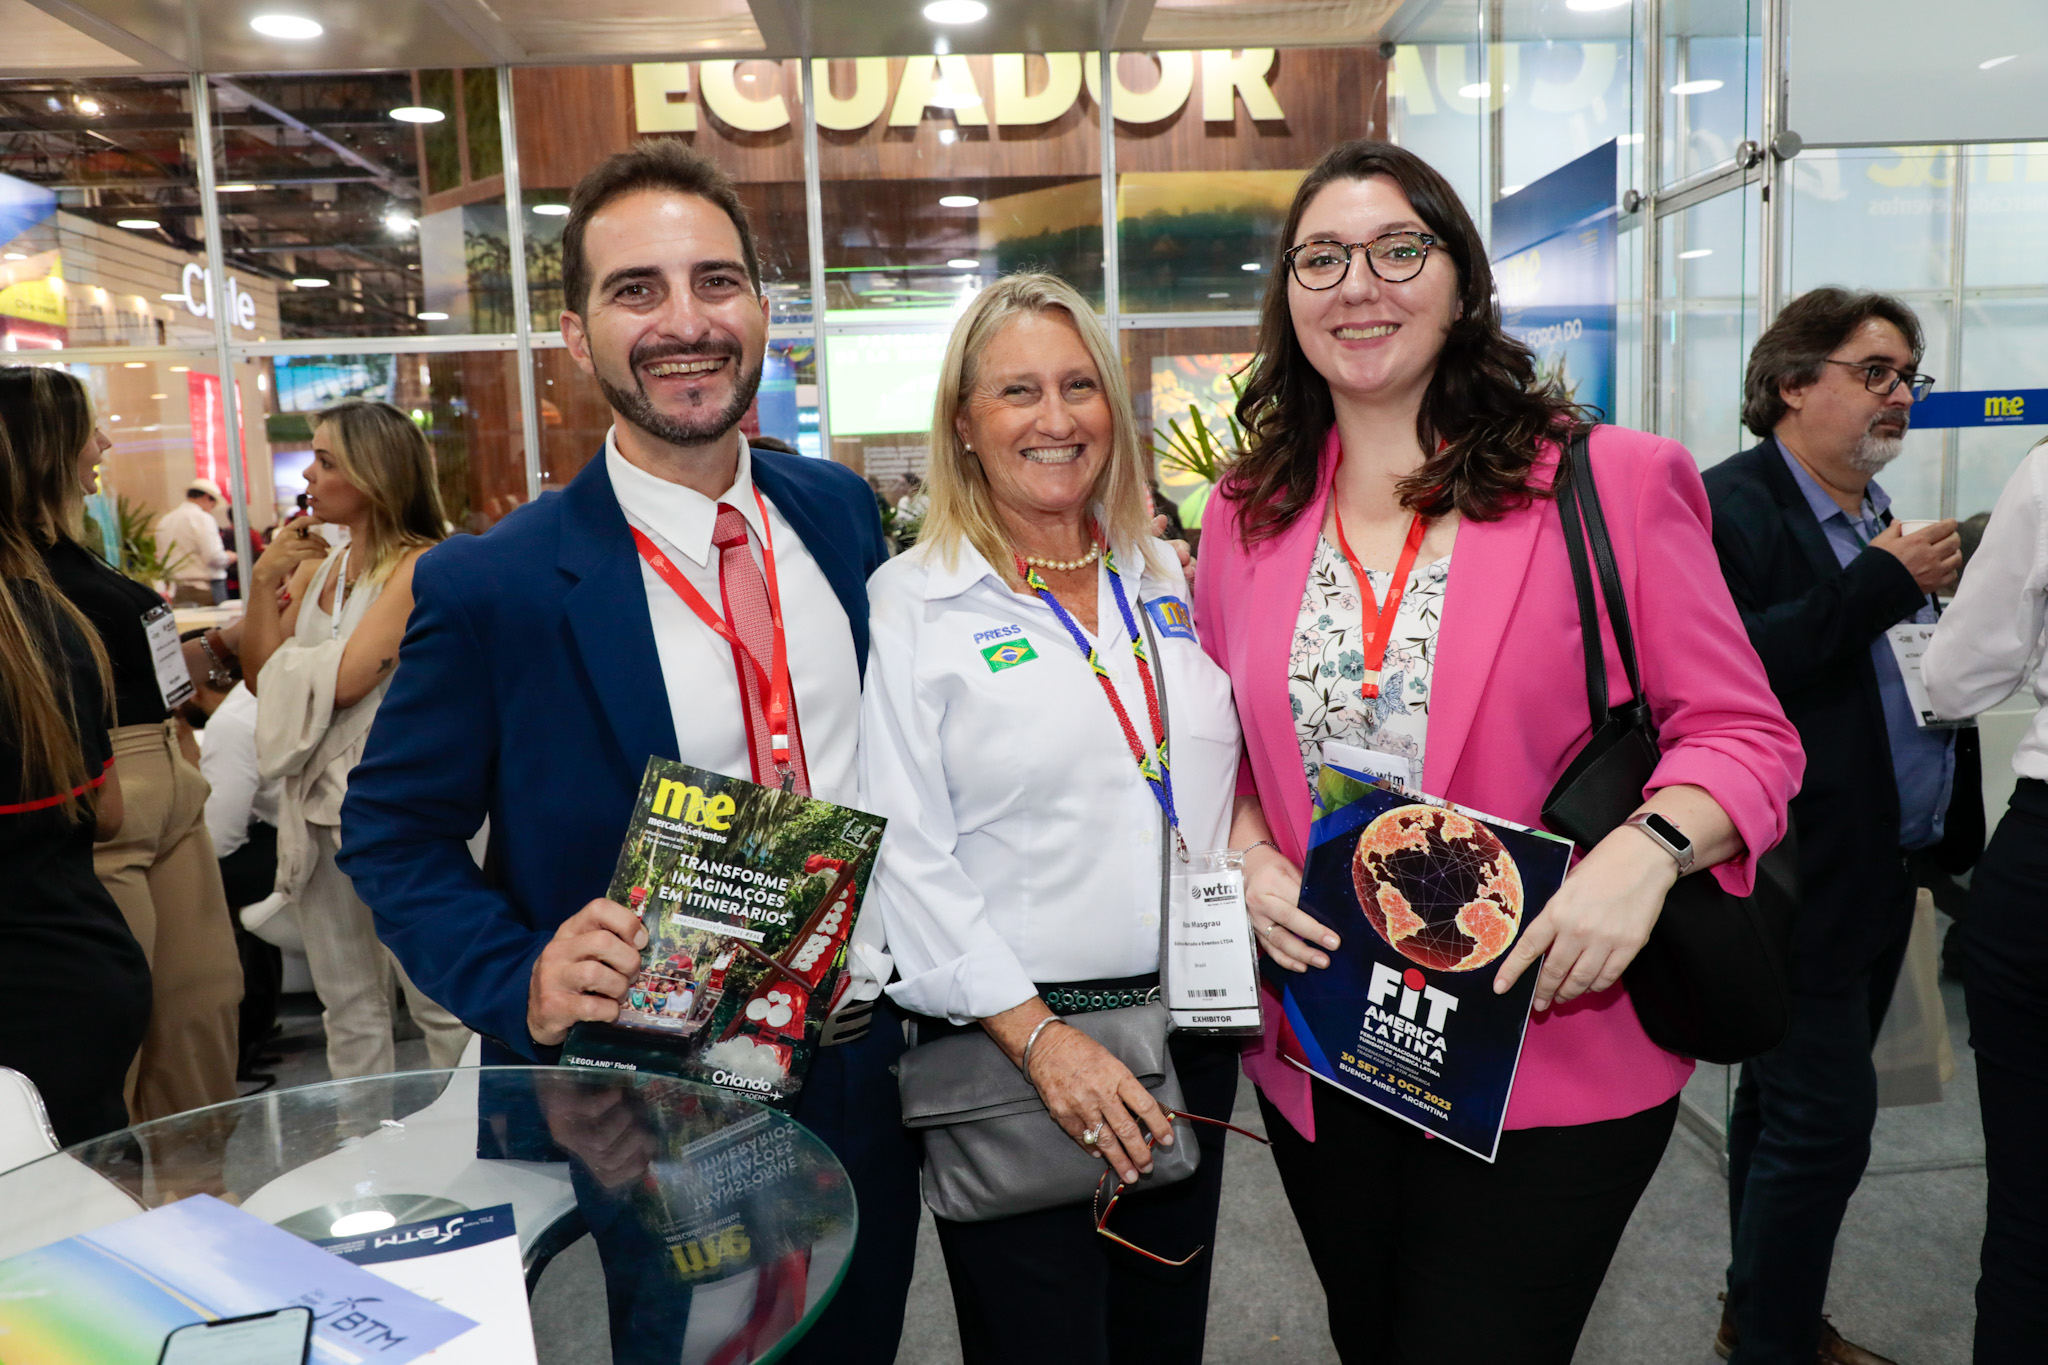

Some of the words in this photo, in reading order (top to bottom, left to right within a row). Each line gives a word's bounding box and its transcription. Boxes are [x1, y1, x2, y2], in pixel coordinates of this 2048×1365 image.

[632, 48, 1285, 133] ECUADOR
[973, 624, 1022, 645] PRESS
[647, 816, 728, 845] mercado&eventos
[672, 870, 786, 909] IMAGINAÇÕES
[679, 853, 790, 892] TRANSFORME
[1203, 883, 1238, 897] wtm
[658, 885, 683, 903] EM
[686, 892, 788, 927] ITINERÁRIOS
[1192, 1015, 1232, 1023] EXHIBITOR
[1364, 1005, 1447, 1052] AMERICA
[1359, 1035, 1384, 1051] TURISMO
[1384, 1047, 1393, 1056] DE
[1393, 1050, 1419, 1068] AMERICA
[1419, 1063, 1441, 1078] LATINA
[1360, 1030, 1376, 1042] FERIA
[1376, 1037, 1422, 1063] INTERNACIONAL
[1422, 1059, 1432, 1067] DE
[1363, 1016, 1444, 1065] LATINA
[614, 1062, 637, 1071] Florida
[712, 1070, 772, 1092] Orlando
[1340, 1051, 1356, 1064] 30
[1357, 1059, 1379, 1076] SET
[1387, 1073, 1396, 1083] 3
[1397, 1079, 1423, 1097] OCT
[1423, 1091, 1452, 1111] 2023
[1338, 1062, 1372, 1083] BUENOS
[1372, 1079, 1397, 1095] AIRES
[1401, 1093, 1449, 1121] ARGENTINA
[374, 1225, 440, 1249] BTM
[329, 1311, 408, 1352] BTM
